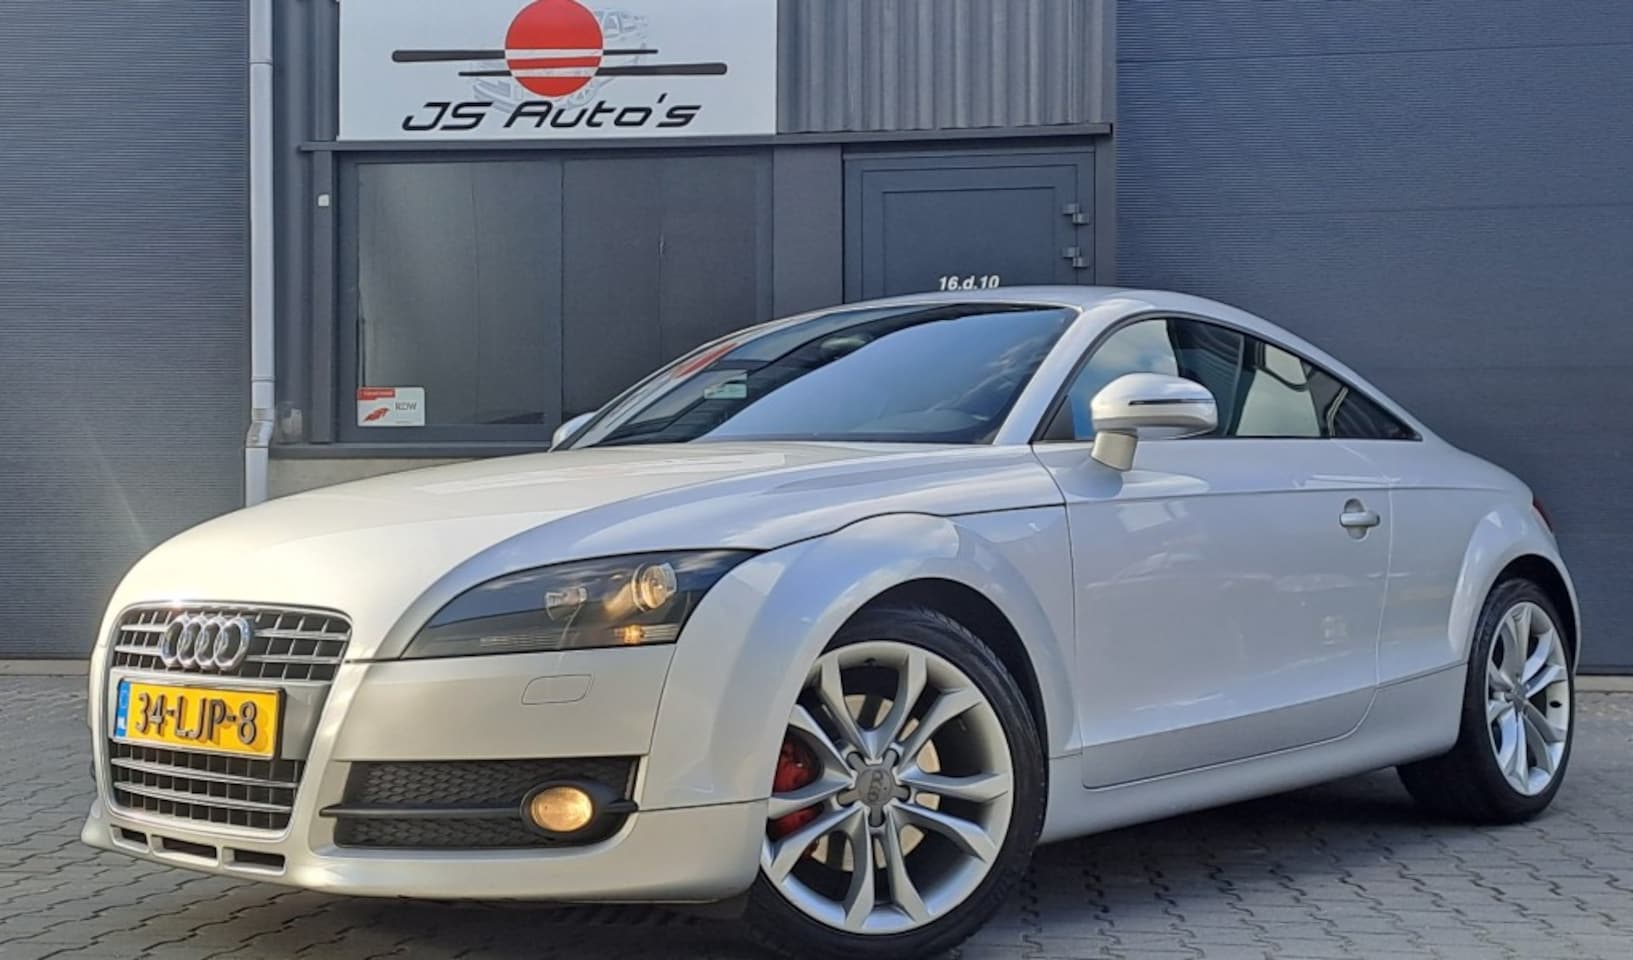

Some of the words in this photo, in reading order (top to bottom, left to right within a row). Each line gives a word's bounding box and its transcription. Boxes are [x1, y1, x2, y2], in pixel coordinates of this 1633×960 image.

[401, 101, 494, 131] JS
[503, 92, 702, 129] Auto's
[938, 275, 1000, 291] 16.d.10
[135, 691, 258, 745] 34-LJP-8
